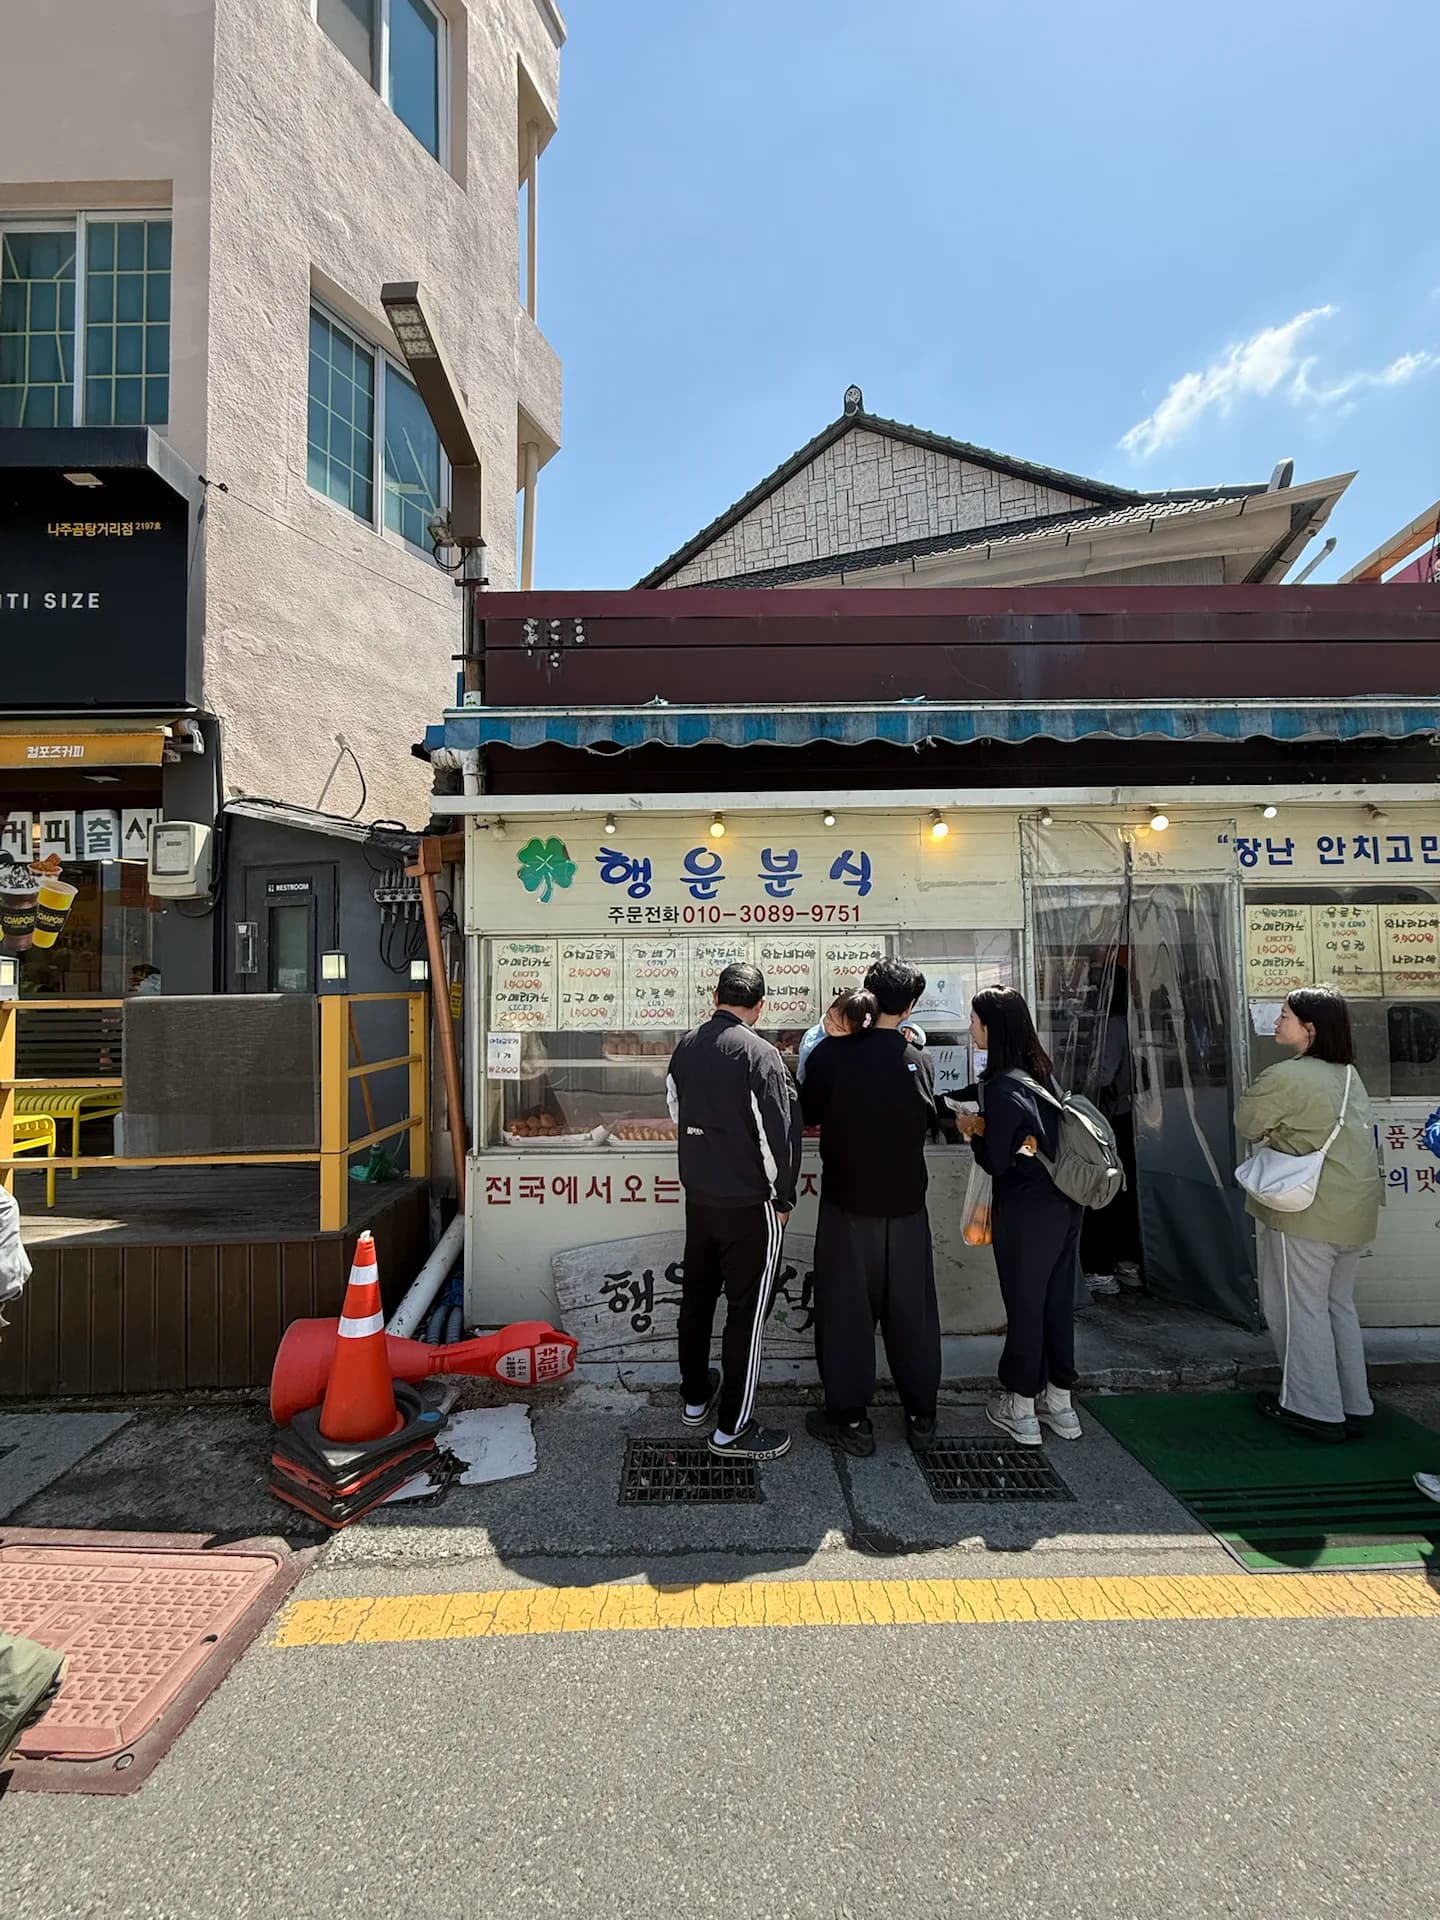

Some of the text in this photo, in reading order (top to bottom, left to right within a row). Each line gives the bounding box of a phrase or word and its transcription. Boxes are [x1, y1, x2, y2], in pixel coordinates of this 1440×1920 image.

[47, 522, 134, 537] 나주곰탕거리점
[44, 592, 100, 609] SIZE
[27, 745, 84, 759] 컴포즈커피
[595, 846, 872, 900] 행운분식
[275, 883, 309, 892] RESTROOM
[607, 904, 861, 924] 주문전화 010-3089-9751
[1250, 920, 1305, 931] 아메리카노
[498, 957, 551, 967] 아메리카노
[1250, 956, 1305, 967] 아메리카노
[496, 992, 550, 1003] 아메리카노
[747, 1450, 777, 1459] crocs
